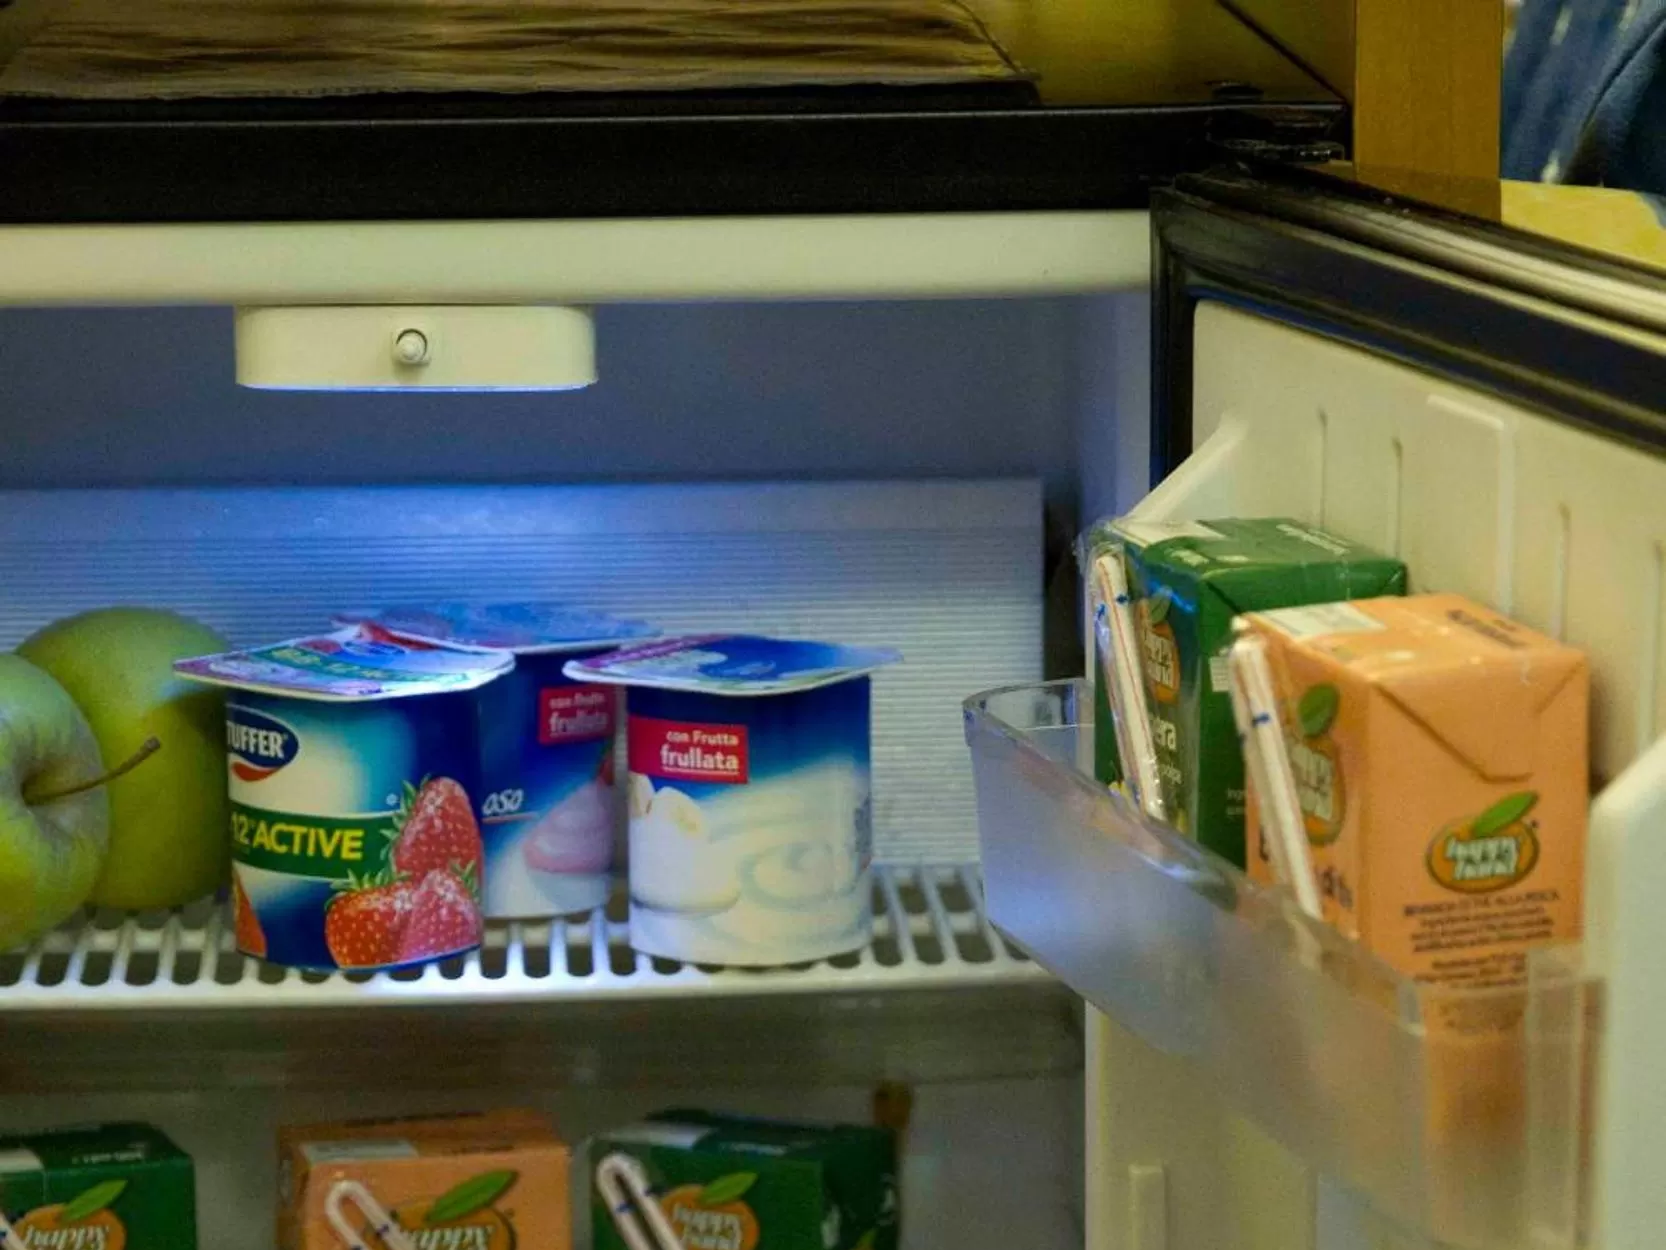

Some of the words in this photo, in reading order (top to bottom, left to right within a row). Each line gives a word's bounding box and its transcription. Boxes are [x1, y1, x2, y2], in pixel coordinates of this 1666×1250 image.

[226, 719, 285, 760] TUFFER
[666, 730, 689, 743] con
[692, 729, 739, 747] Frutta
[660, 745, 739, 771] frullata
[252, 820, 365, 861] ACTIVE
